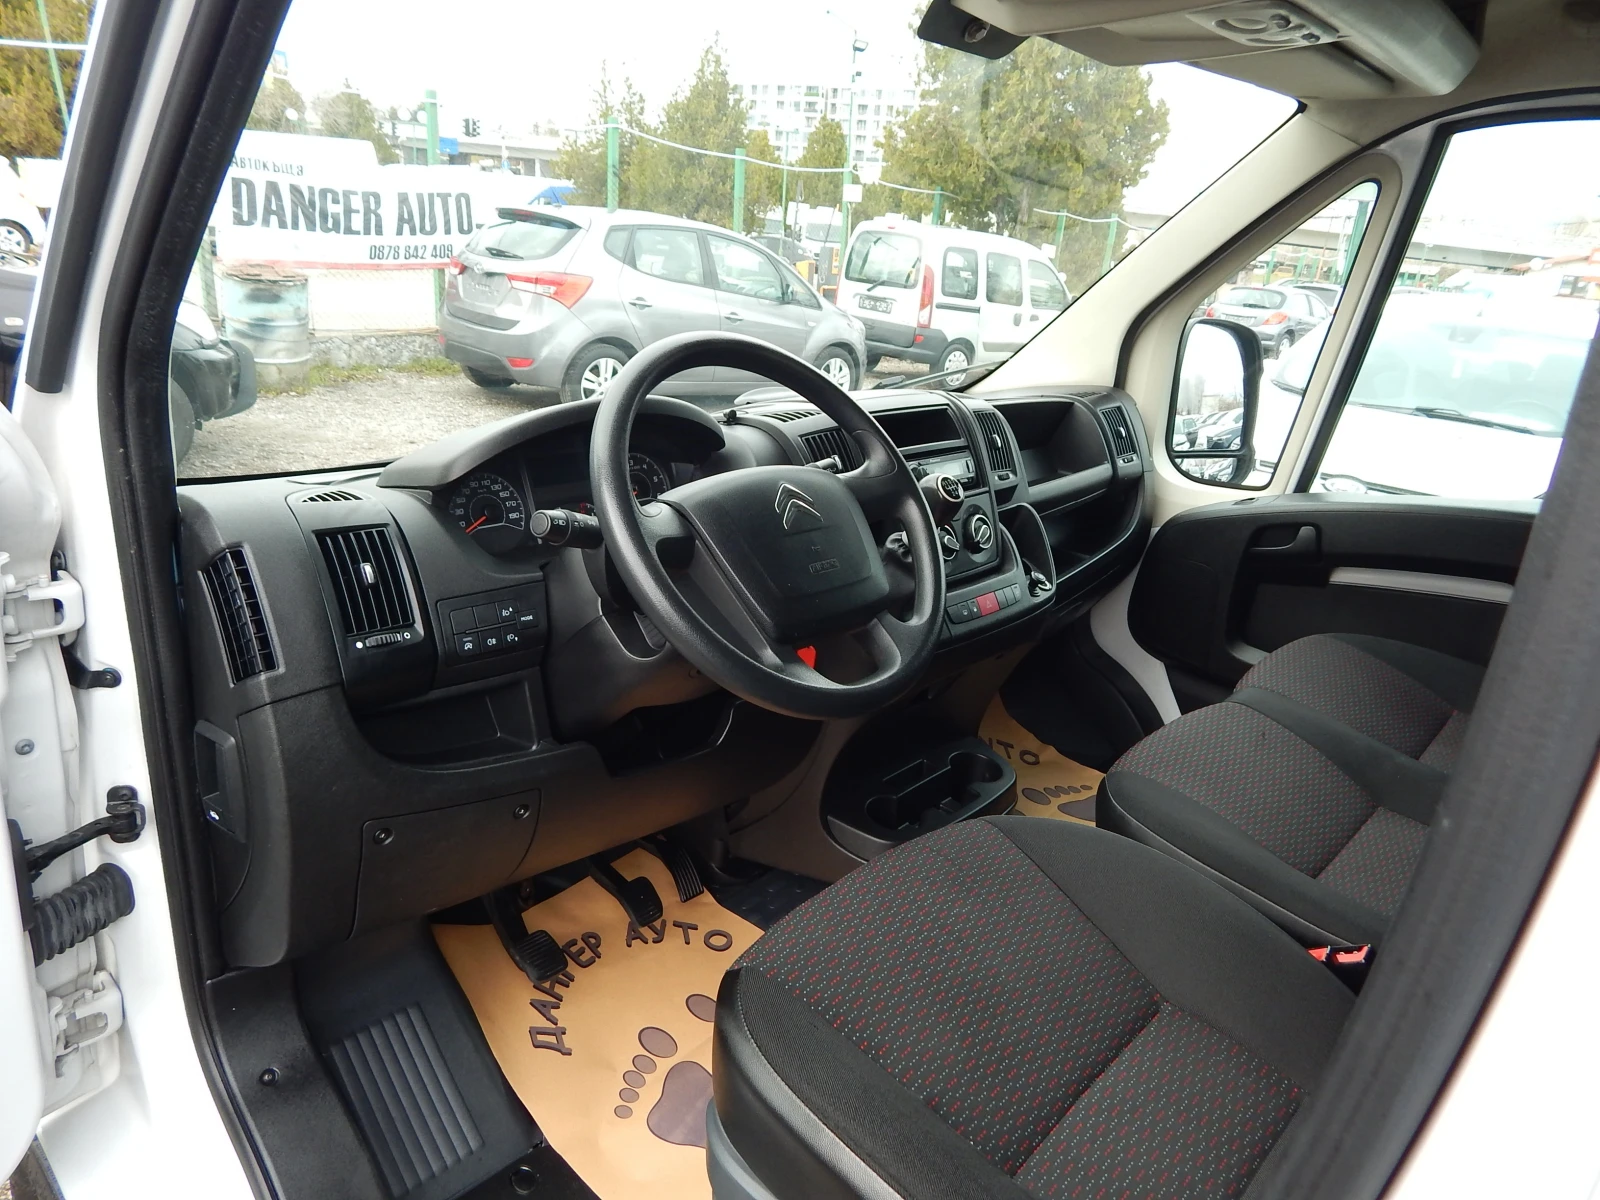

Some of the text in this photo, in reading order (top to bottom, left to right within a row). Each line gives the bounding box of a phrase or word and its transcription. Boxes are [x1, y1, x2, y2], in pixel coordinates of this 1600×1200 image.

[231, 176, 384, 236] DANGER
[369, 243, 453, 261] 0878 842 409
[625, 918, 733, 952] АУТО
